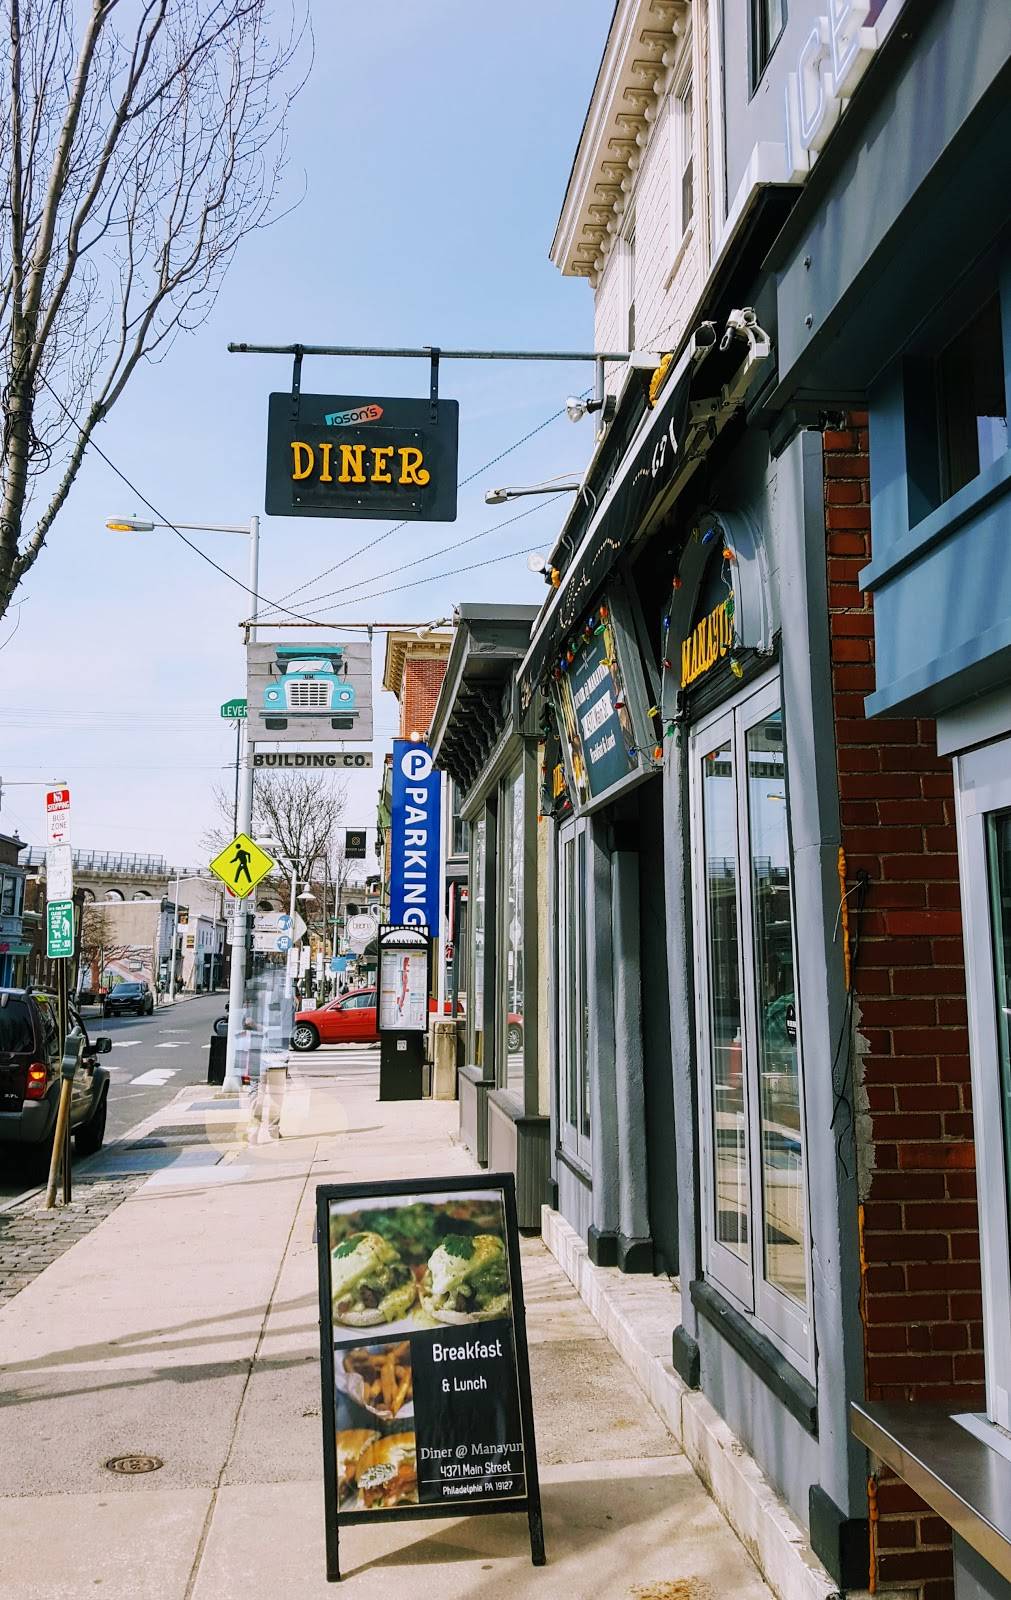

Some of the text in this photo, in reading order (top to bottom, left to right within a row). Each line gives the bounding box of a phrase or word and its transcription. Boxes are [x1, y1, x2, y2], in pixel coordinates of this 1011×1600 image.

[290, 441, 430, 486] DINER
[253, 754, 371, 767] BUILDING CO.
[410, 755, 426, 776] P
[52, 813, 66, 822] BUS
[51, 821, 68, 831] ZONE
[403, 787, 428, 926] PARKING
[432, 1339, 503, 1362] Breakfast
[442, 1376, 488, 1392] & Lunch
[420, 1447, 453, 1460] Diner
[455, 1445, 468, 1459] @
[440, 1460, 512, 1478] 4371 Main Street
[443, 1480, 513, 1496] Philadelphia PA 19127
